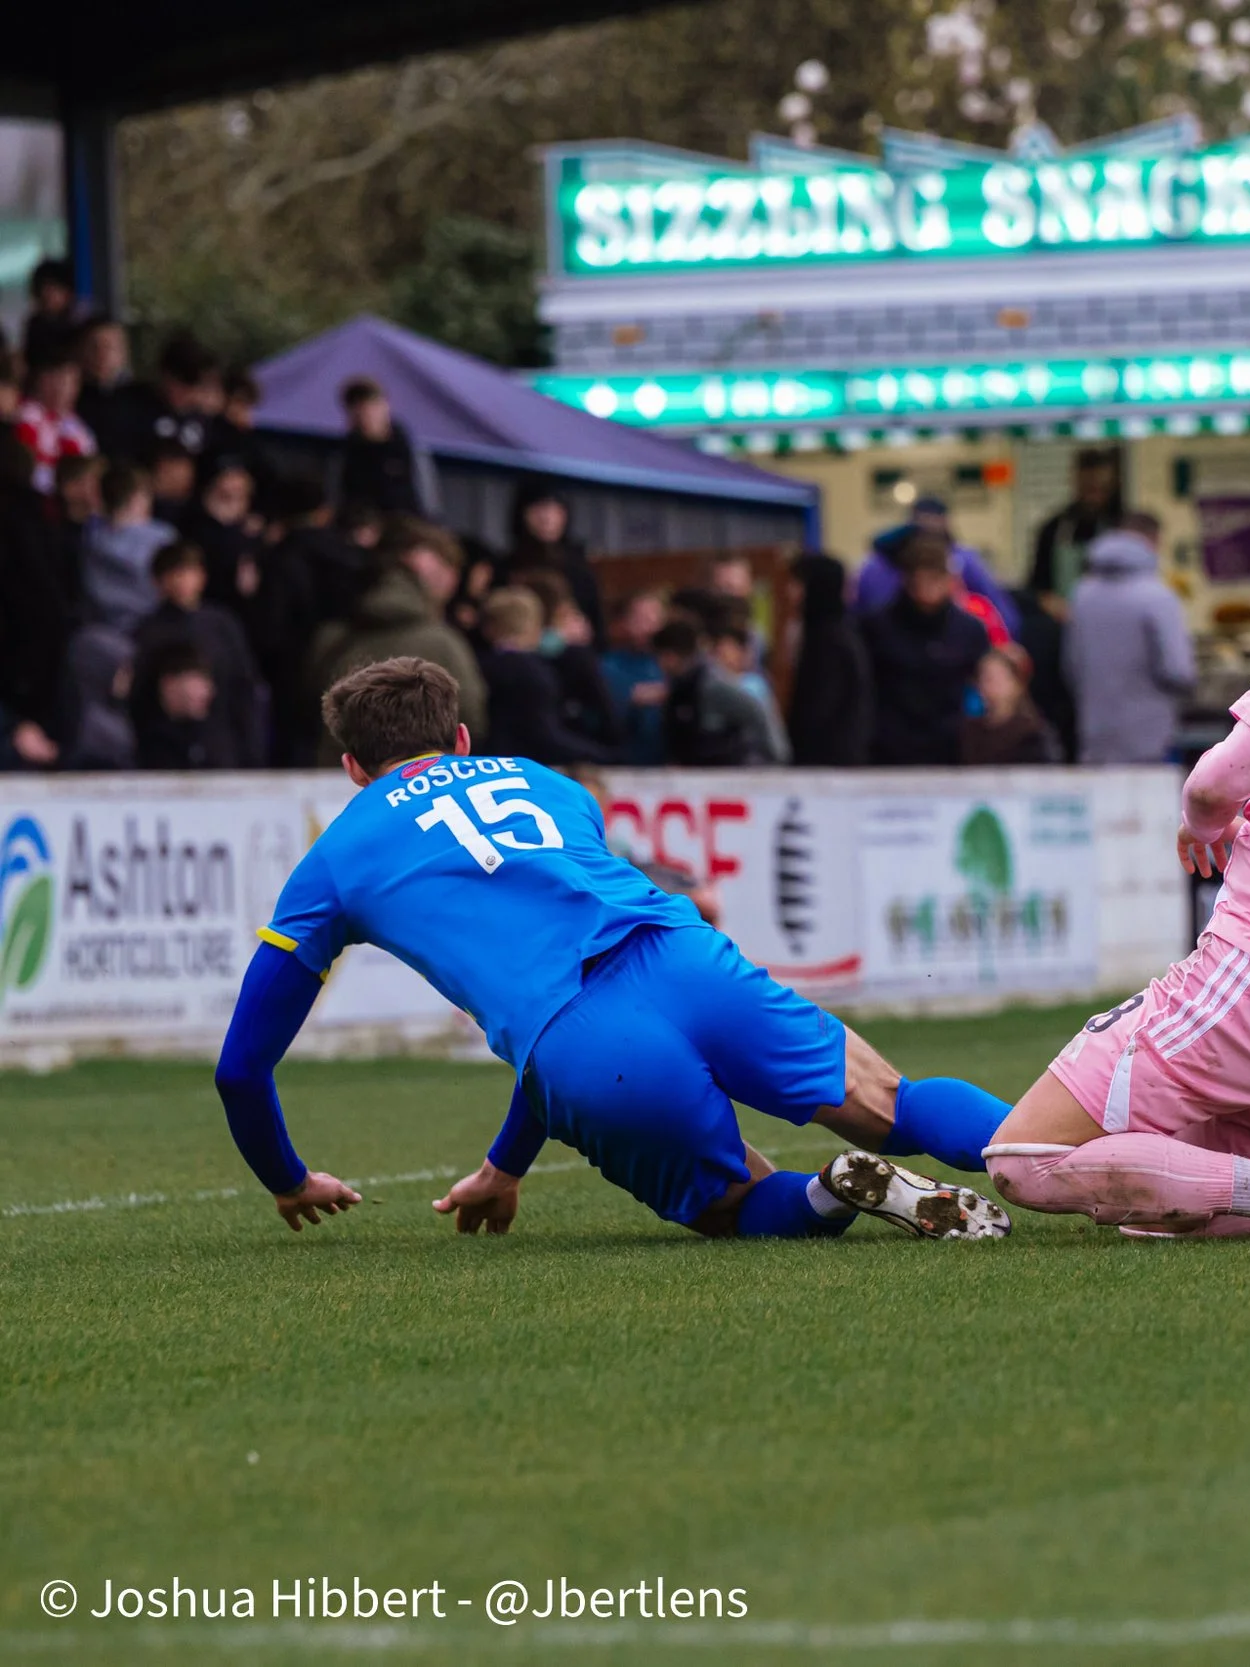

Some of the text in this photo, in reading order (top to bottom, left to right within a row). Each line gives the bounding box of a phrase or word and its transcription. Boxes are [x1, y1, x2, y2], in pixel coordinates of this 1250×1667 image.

[574, 170, 953, 266] SIZZLING
[385, 757, 523, 808] ROSCOE
[415, 776, 564, 875] 15
[62, 814, 237, 924] Ashton
[62, 928, 238, 983] HORTICULTURE
[1086, 995, 1144, 1033] 8
